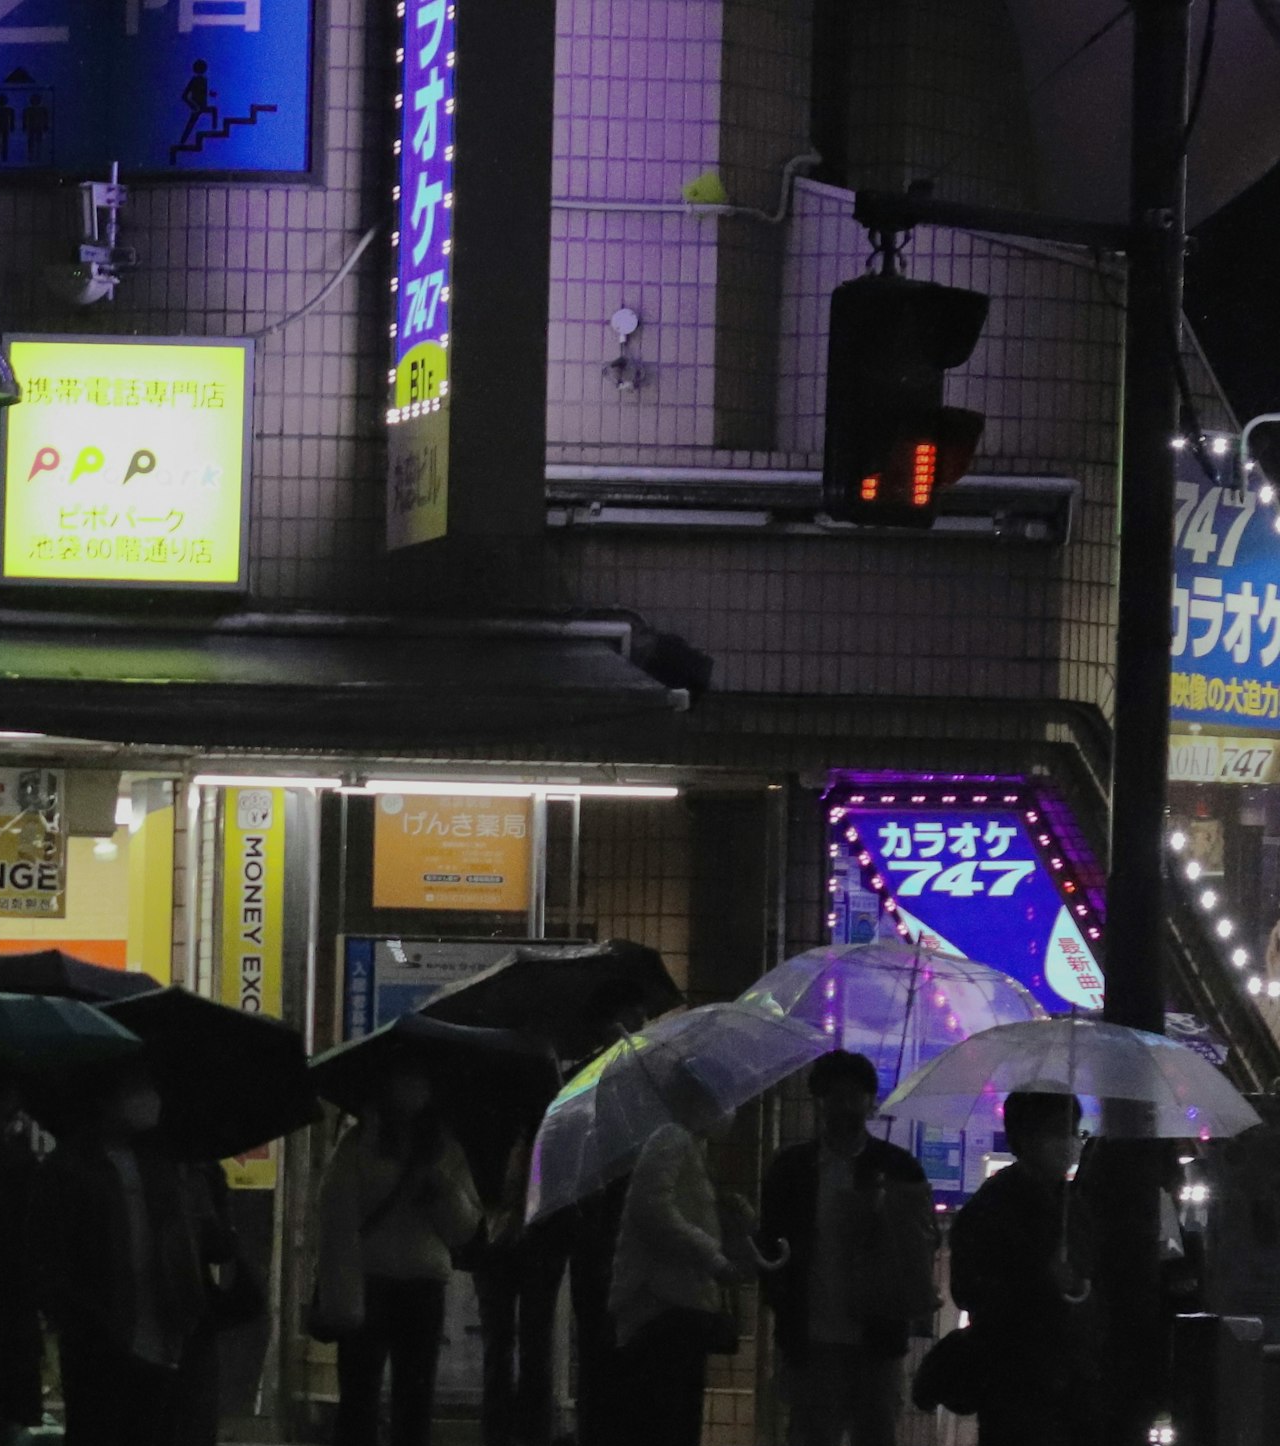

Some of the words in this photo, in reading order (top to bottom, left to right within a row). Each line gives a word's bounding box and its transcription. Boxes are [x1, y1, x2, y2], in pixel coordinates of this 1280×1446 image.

[404, 271, 446, 339] 747
[1174, 481, 1256, 567] 747
[1169, 744, 1216, 777] OKE
[1221, 747, 1273, 778] 747
[402, 812, 527, 839] げんき薬局
[878, 820, 1018, 859] カラオケ
[243, 837, 263, 945] MONEY
[887, 860, 1036, 897] 747
